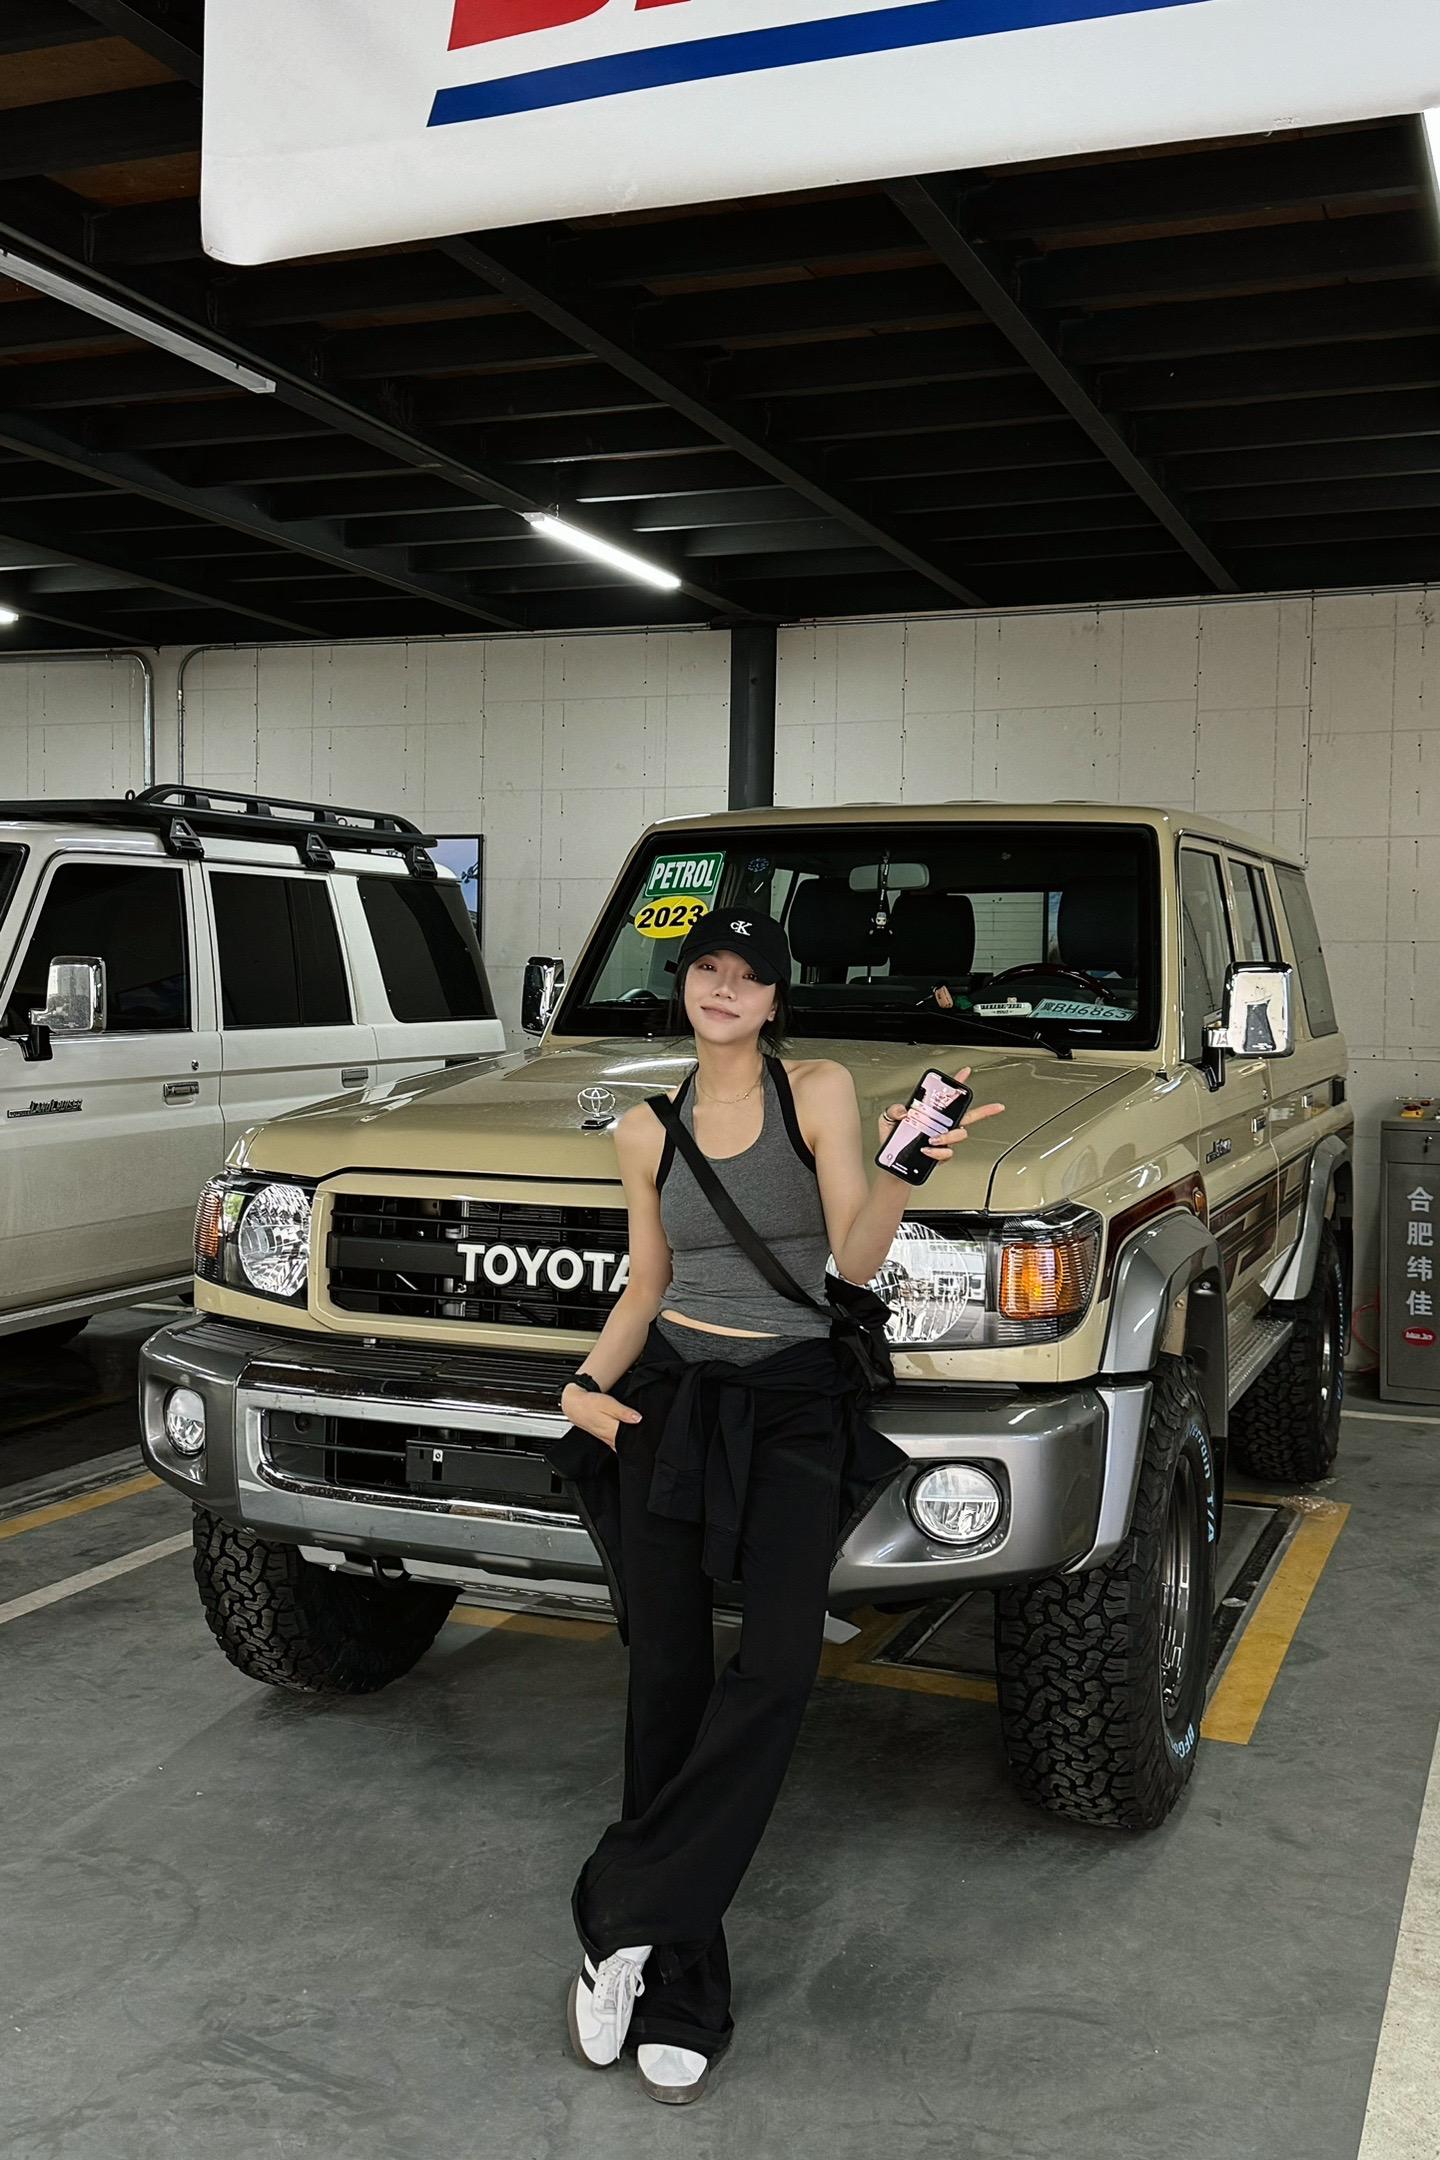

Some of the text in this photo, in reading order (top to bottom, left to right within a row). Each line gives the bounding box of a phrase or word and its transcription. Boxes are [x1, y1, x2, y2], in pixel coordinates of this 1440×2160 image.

[648, 859, 715, 890] PETROL
[636, 904, 705, 929] 2023
[1406, 1186, 1435, 1317] 合肥纬佳
